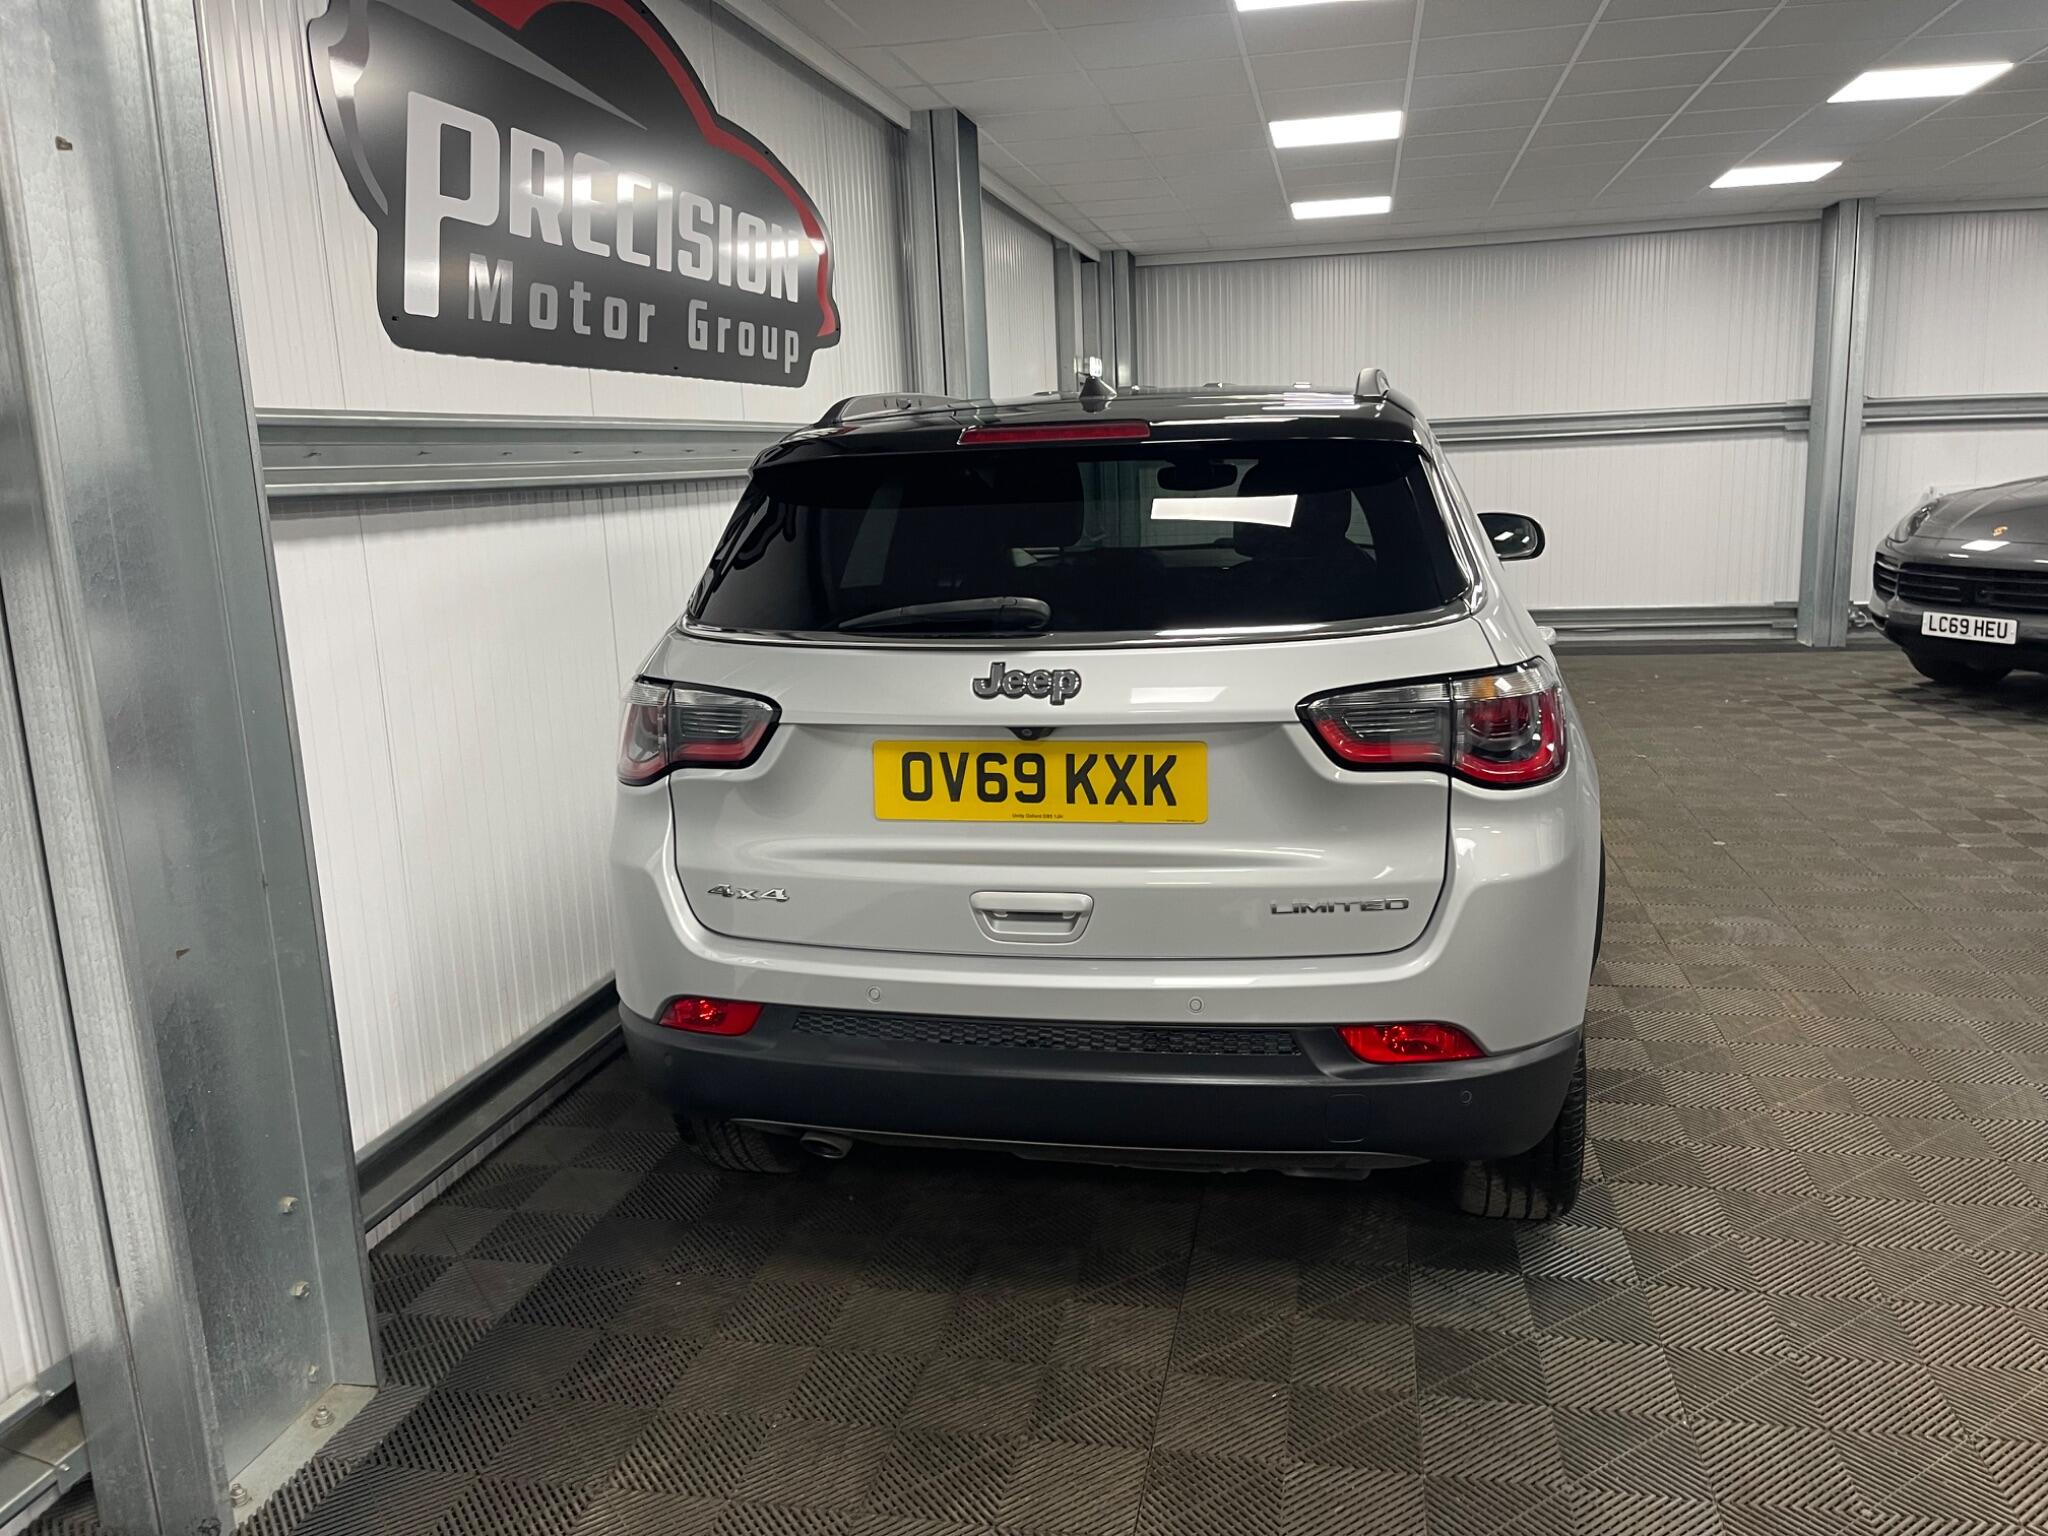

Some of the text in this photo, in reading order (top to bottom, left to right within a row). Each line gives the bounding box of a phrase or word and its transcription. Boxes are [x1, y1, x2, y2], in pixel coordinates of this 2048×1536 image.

[404, 91, 799, 318] PRECISION
[467, 252, 800, 374] Motor Group
[1929, 615, 2008, 639] LC69 HEU
[971, 661, 1083, 706] Jeep
[901, 751, 1178, 807] OV69 KXK
[707, 883, 790, 903] 4x4
[1270, 898, 1410, 914] LIMITED
